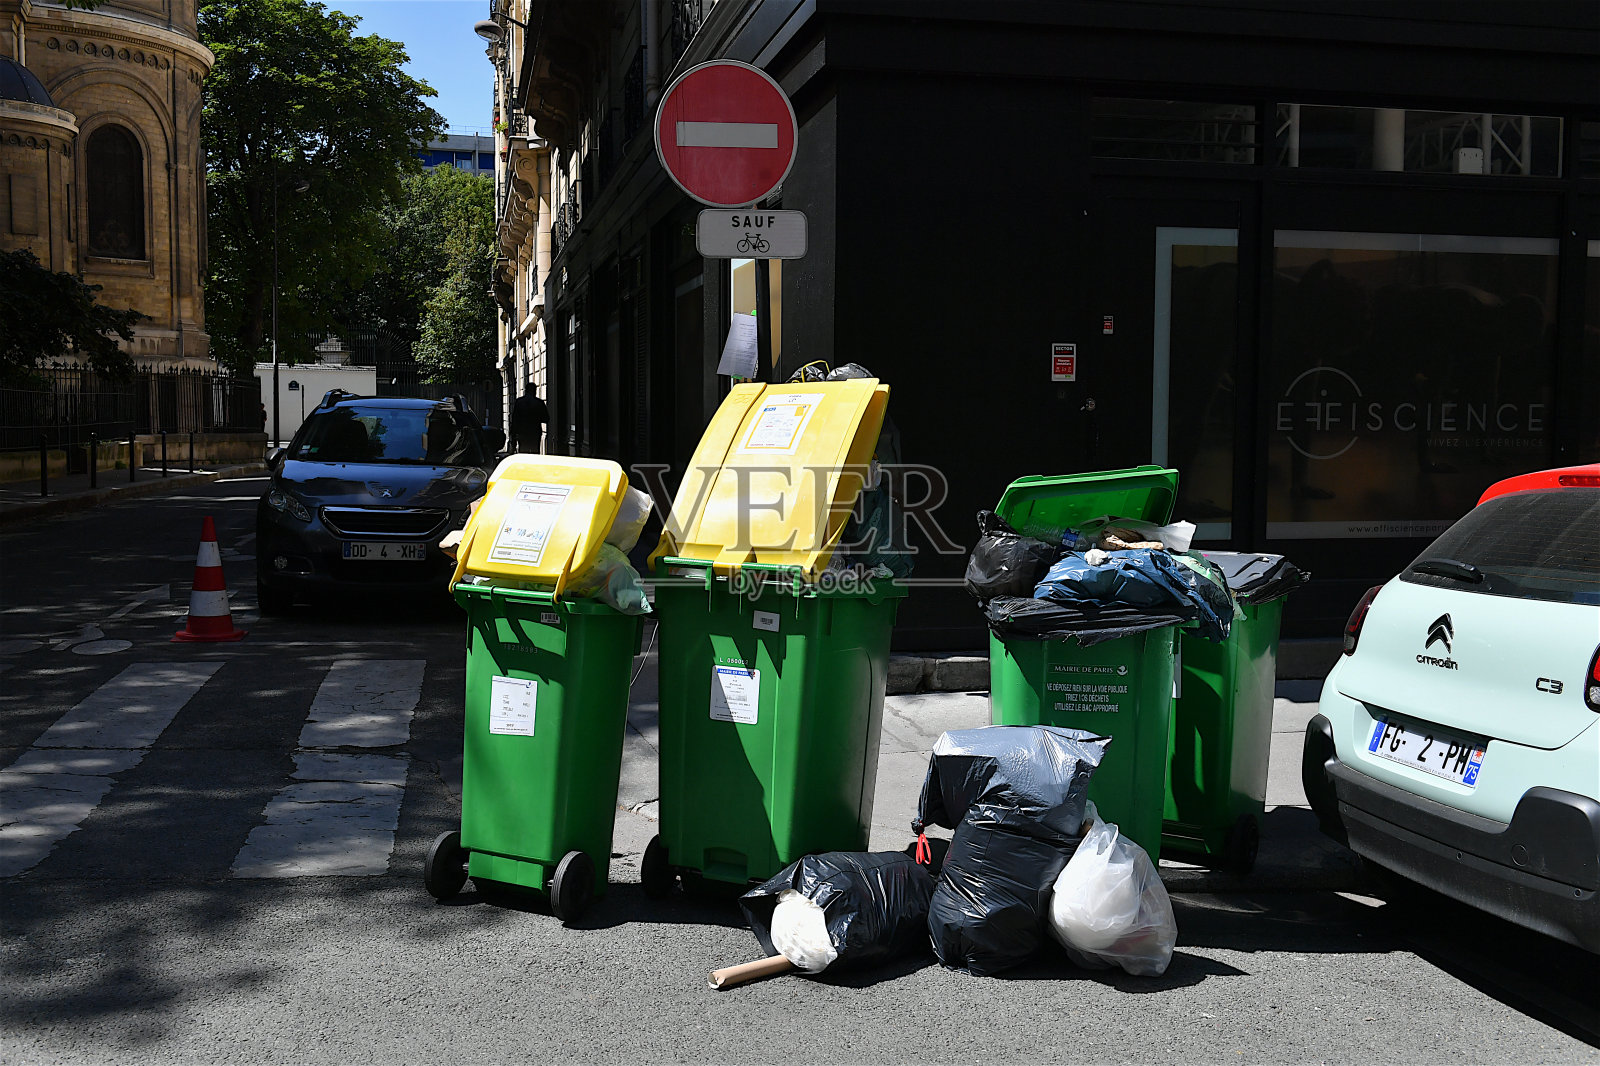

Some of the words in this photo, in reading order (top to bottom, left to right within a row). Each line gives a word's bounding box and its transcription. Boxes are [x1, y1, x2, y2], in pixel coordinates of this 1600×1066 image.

[731, 216, 776, 228] SAUF
[1276, 402, 1545, 432] EFFISCIENCE
[1426, 438, 1458, 447] VIVEZ
[1053, 682, 1071, 692] DÉPOSEZ
[1108, 685, 1127, 693] PUBLIQUE
[1536, 677, 1564, 694] C3
[1089, 693, 1109, 702] DÉCHETS
[1054, 703, 1074, 711] UTILISEZ
[1075, 703, 1081, 711] LE
[1093, 703, 1119, 712] APPROPRIÉ
[1417, 735, 1434, 762] 2
[1465, 764, 1479, 780] 75
